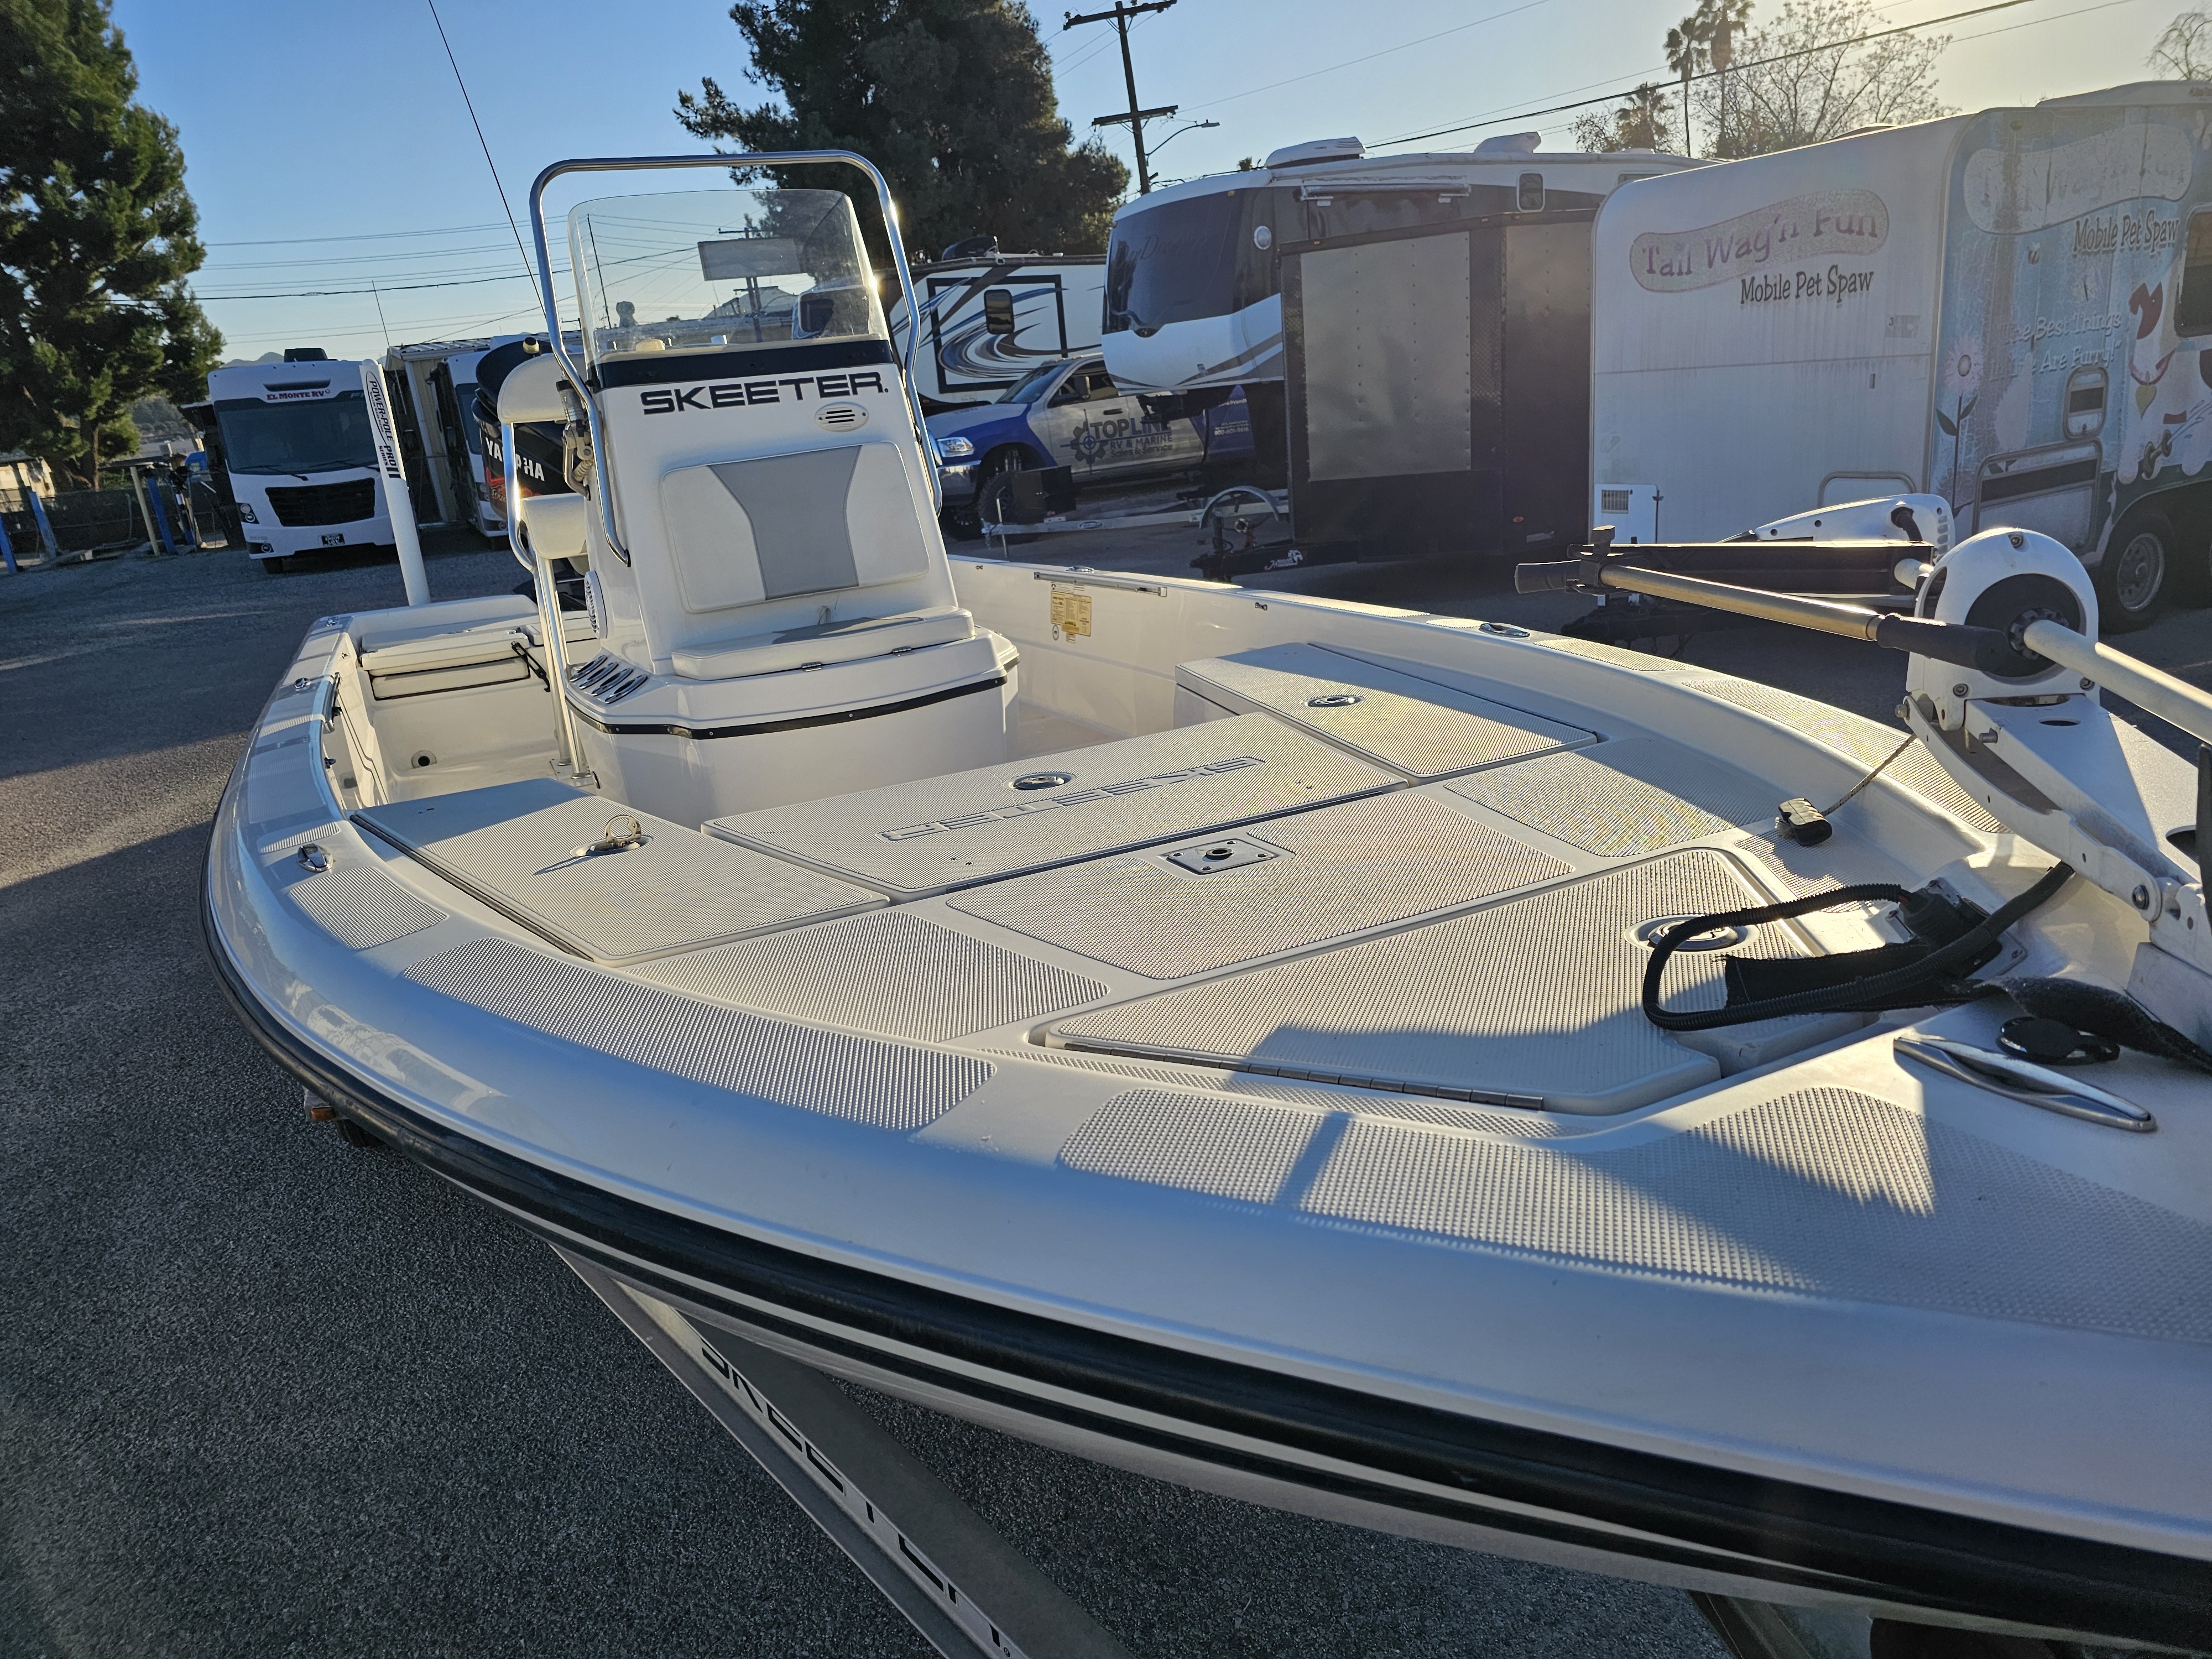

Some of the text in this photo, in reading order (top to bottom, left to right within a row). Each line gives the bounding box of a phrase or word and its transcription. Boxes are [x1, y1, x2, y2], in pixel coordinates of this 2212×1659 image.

[1642, 208, 1879, 276] Tail Wag'n Fun
[2074, 209, 2179, 253] Mobile Pet Spaw
[1740, 264, 1874, 305] Mobile Pet Spaw
[2035, 316, 2069, 341] Best
[279, 392, 311, 400] MONTE
[640, 371, 886, 415] SKEETER
[369, 380, 394, 442] POWER-POLE
[1090, 417, 1172, 440] TOPLIN
[1110, 441, 1123, 450] RV
[1136, 434, 1173, 446] MARINE
[1110, 448, 1133, 458] Sales
[1142, 444, 1173, 454] Service
[378, 445, 389, 466] SERIES
[383, 445, 397, 466] PRO
[486, 437, 545, 482] YAAHA
